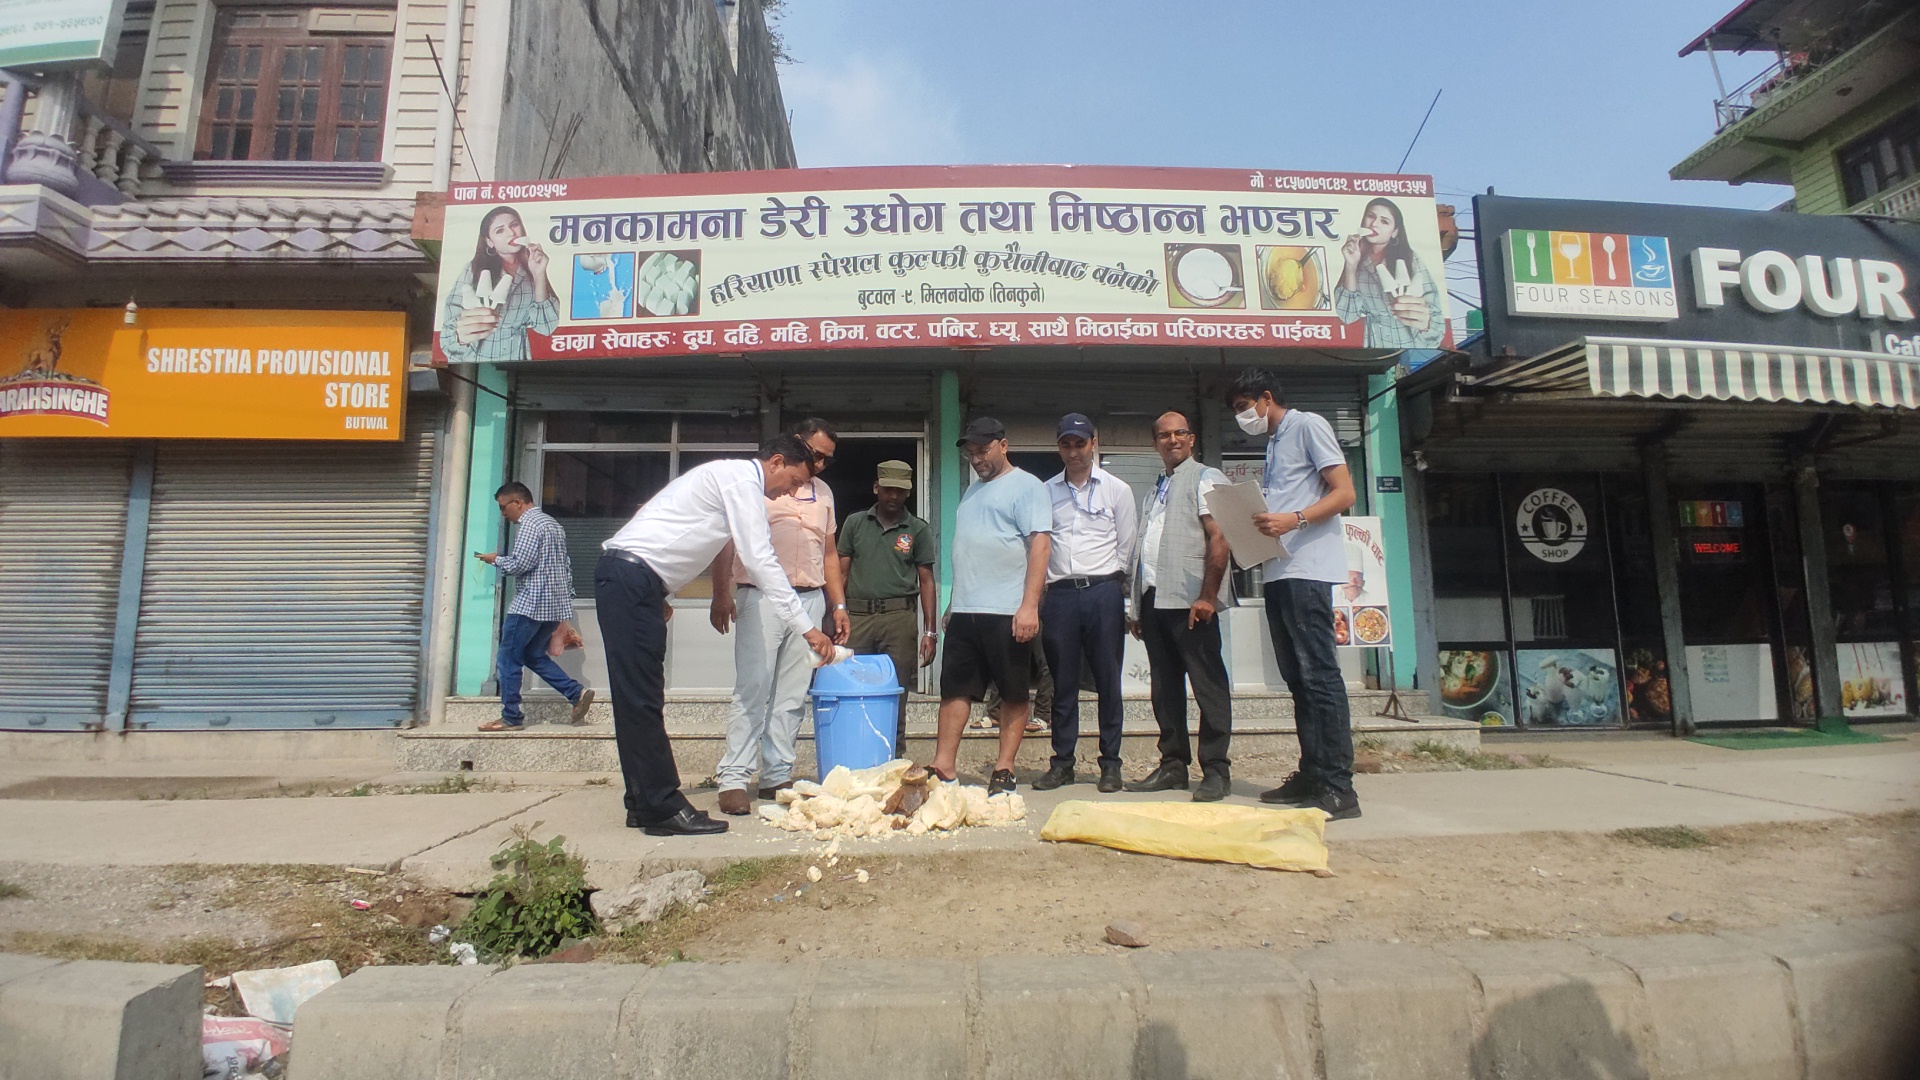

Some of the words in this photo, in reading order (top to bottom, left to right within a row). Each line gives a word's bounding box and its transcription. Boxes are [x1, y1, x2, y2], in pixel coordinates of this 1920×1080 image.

[454, 187, 478, 200] पान
[498, 183, 567, 200] ६१०८०२५१९
[549, 208, 748, 246] मनकामना
[759, 195, 831, 239] डेरी
[959, 201, 1036, 236] तथा
[1048, 190, 1206, 236] मिष्ठान्न
[1219, 204, 1340, 240] भण्डार
[707, 264, 803, 307] हरियाणा
[808, 252, 883, 281] स्पेशल
[888, 244, 968, 277] कुल्फी
[1092, 261, 1161, 296] बनेको
[1691, 247, 1915, 321] FOUR
[858, 288, 896, 310] बुटवल
[920, 282, 985, 304] मिलनचोक
[989, 281, 1045, 308] (तिनकुने)
[1516, 286, 1568, 304] FOUR
[1579, 288, 1675, 307] SEASONS
[551, 333, 596, 352] हाम्रा
[724, 322, 764, 345] दहि,
[770, 321, 813, 343] महि,
[876, 323, 921, 340] वटर,
[928, 316, 983, 340] पनिर,
[1028, 316, 1070, 338] साथै
[1075, 316, 1158, 340] मिठाईका
[1271, 320, 1332, 342] पाईन्छ
[147, 347, 251, 374] SHRESTHA
[256, 349, 391, 376] PROVISIONAL
[324, 382, 390, 408] STORE
[345, 416, 389, 430] BUTWAL
[1523, 491, 1578, 514] COFFEE
[1541, 549, 1569, 558] SHOP
[1693, 542, 1740, 553] WELCOME
